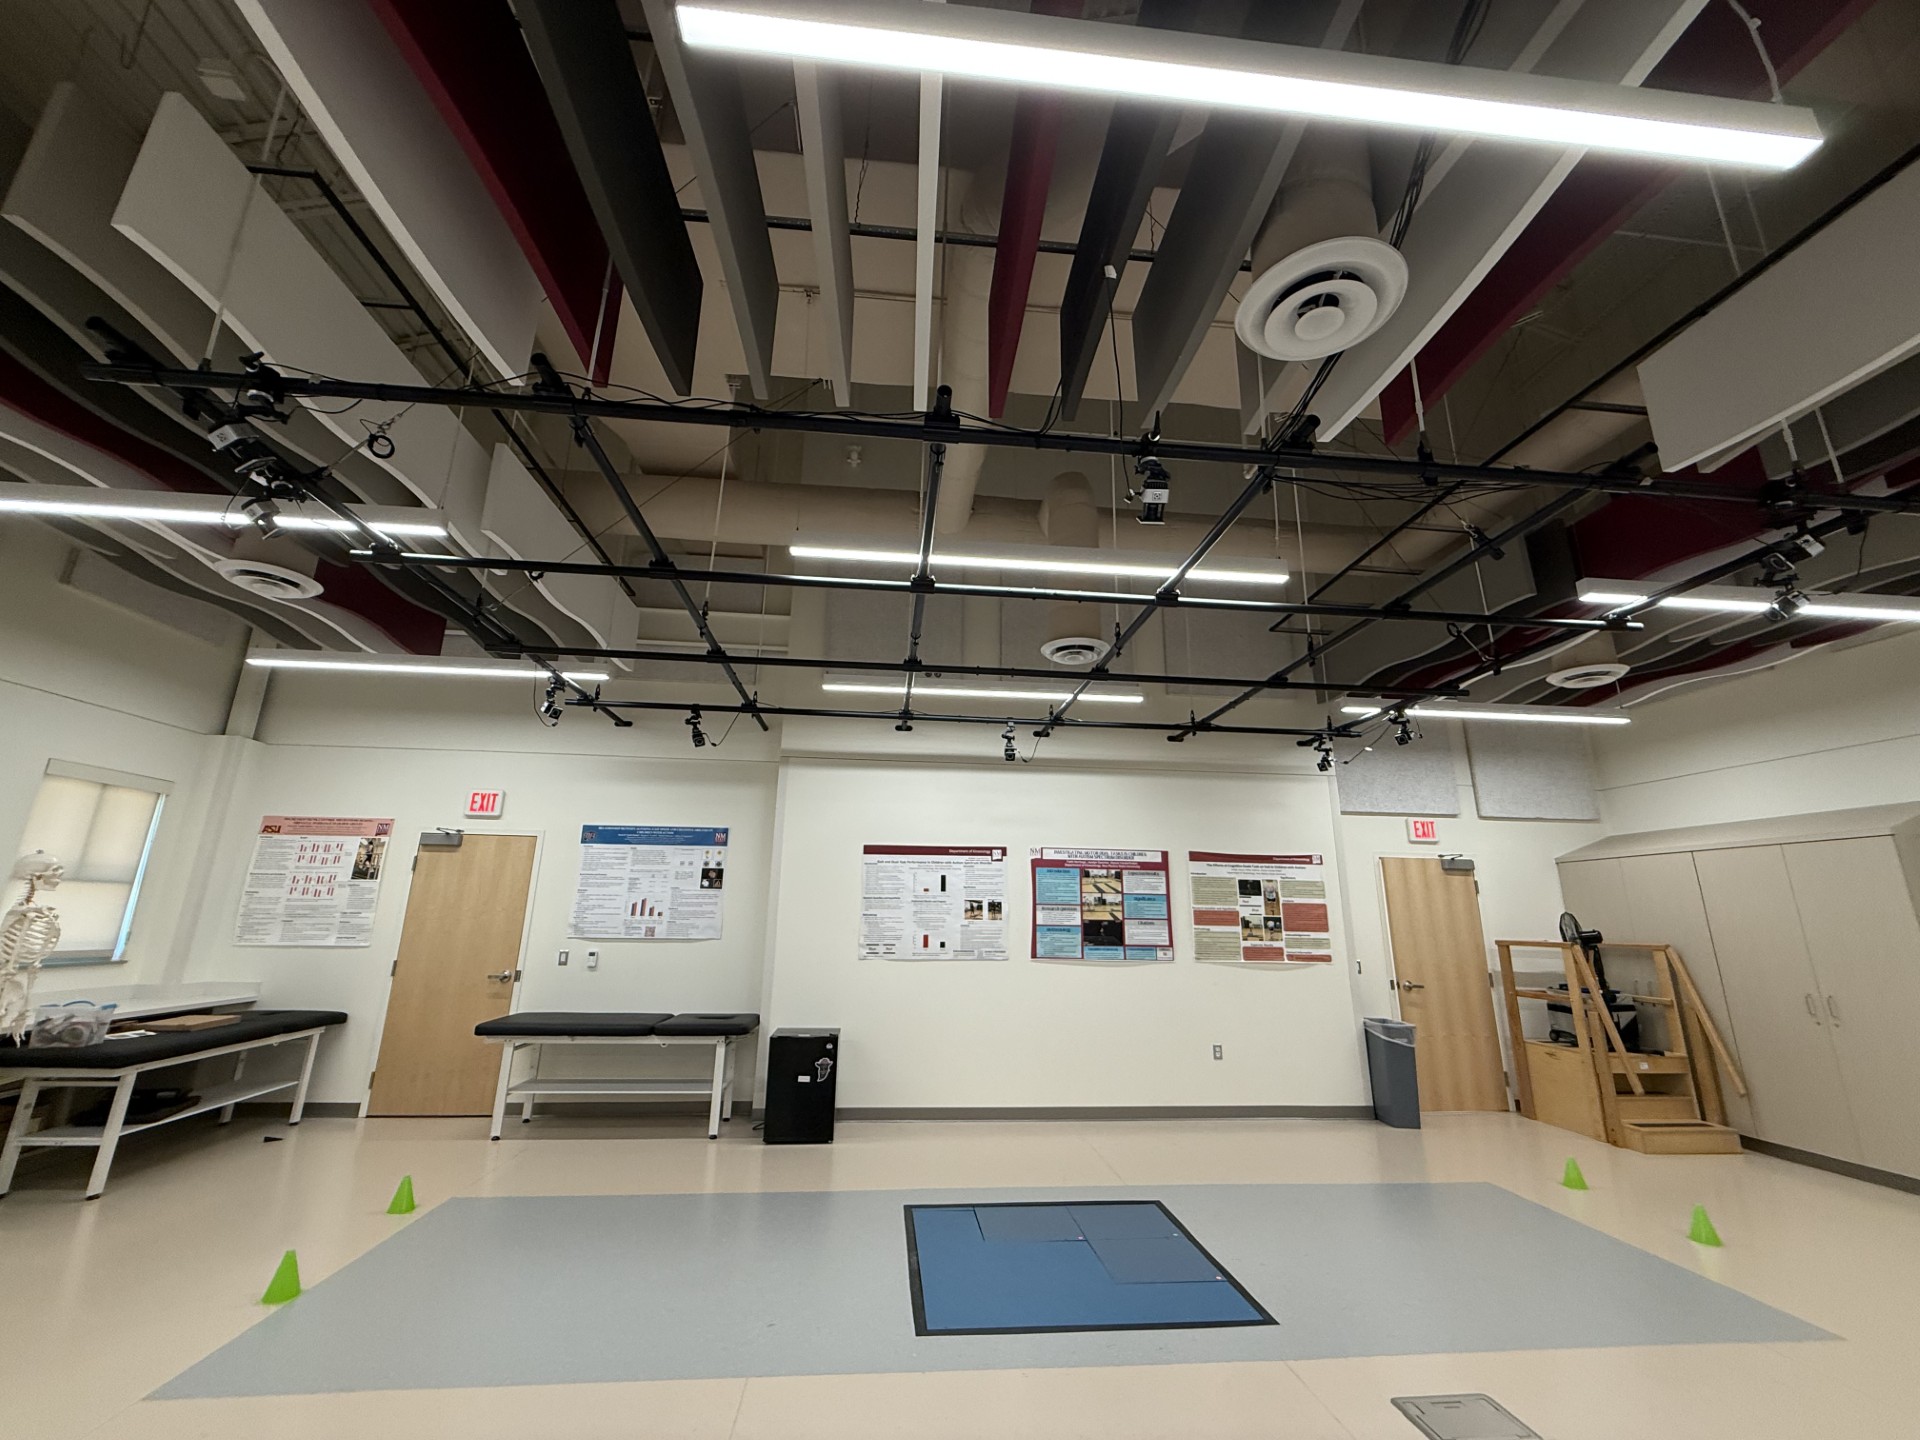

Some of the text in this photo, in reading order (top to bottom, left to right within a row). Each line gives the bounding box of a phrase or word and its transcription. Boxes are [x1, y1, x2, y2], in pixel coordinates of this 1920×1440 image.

[470, 792, 499, 812] EXIT
[262, 825, 282, 833] ASU
[1413, 820, 1436, 838] EXIT
